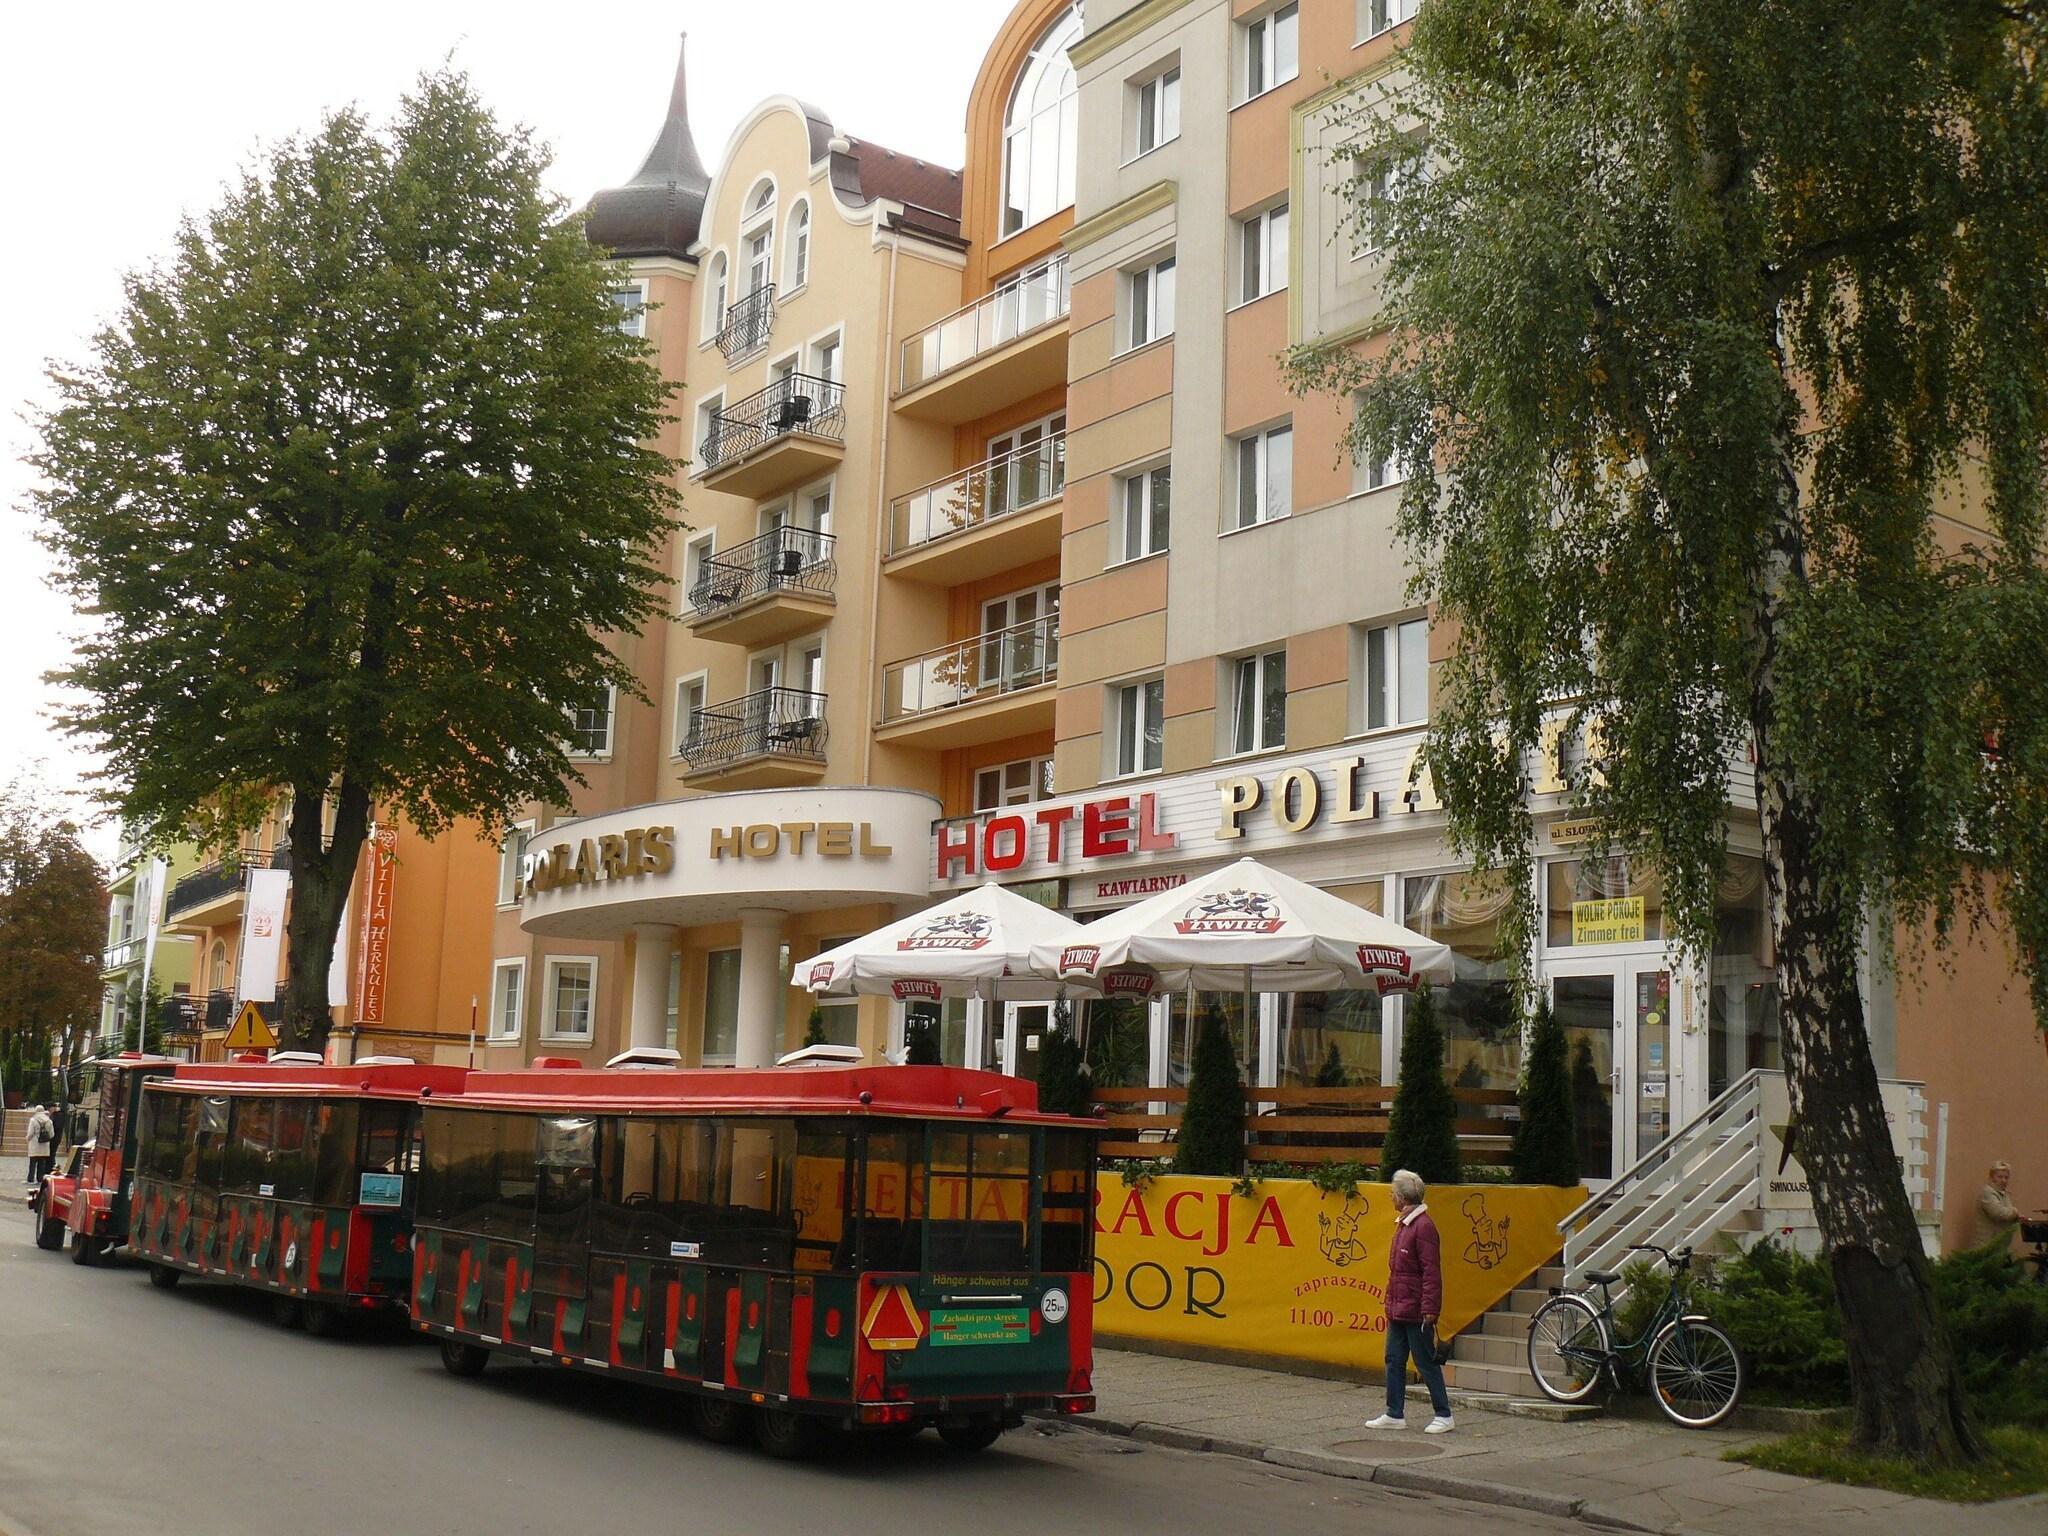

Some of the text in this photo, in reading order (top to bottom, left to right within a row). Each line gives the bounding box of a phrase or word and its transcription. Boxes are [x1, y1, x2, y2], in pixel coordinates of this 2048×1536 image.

[937, 714, 1628, 880] HOTEL POLAI
[521, 822, 893, 897] POLARIS HOTEL
[1097, 874, 1187, 898] KAWIARNIA
[1576, 900, 1640, 923] WOLNE POKOJE
[1189, 917, 1272, 931] ŻYWIEC
[1577, 922, 1640, 943] Zimmer frei
[367, 853, 392, 1022] VILLA HERKULES
[909, 936, 979, 948] ŻYWIEC
[1064, 947, 1097, 966] ŻYWIEC
[1362, 945, 1404, 966] ŻYWIEC
[933, 1274, 967, 1287] Hänger
[1013, 1277, 1029, 1285] aus
[976, 1315, 991, 1323] przy
[1290, 1307, 1333, 1328] 11.00
[1349, 1312, 1388, 1333] 22.0
